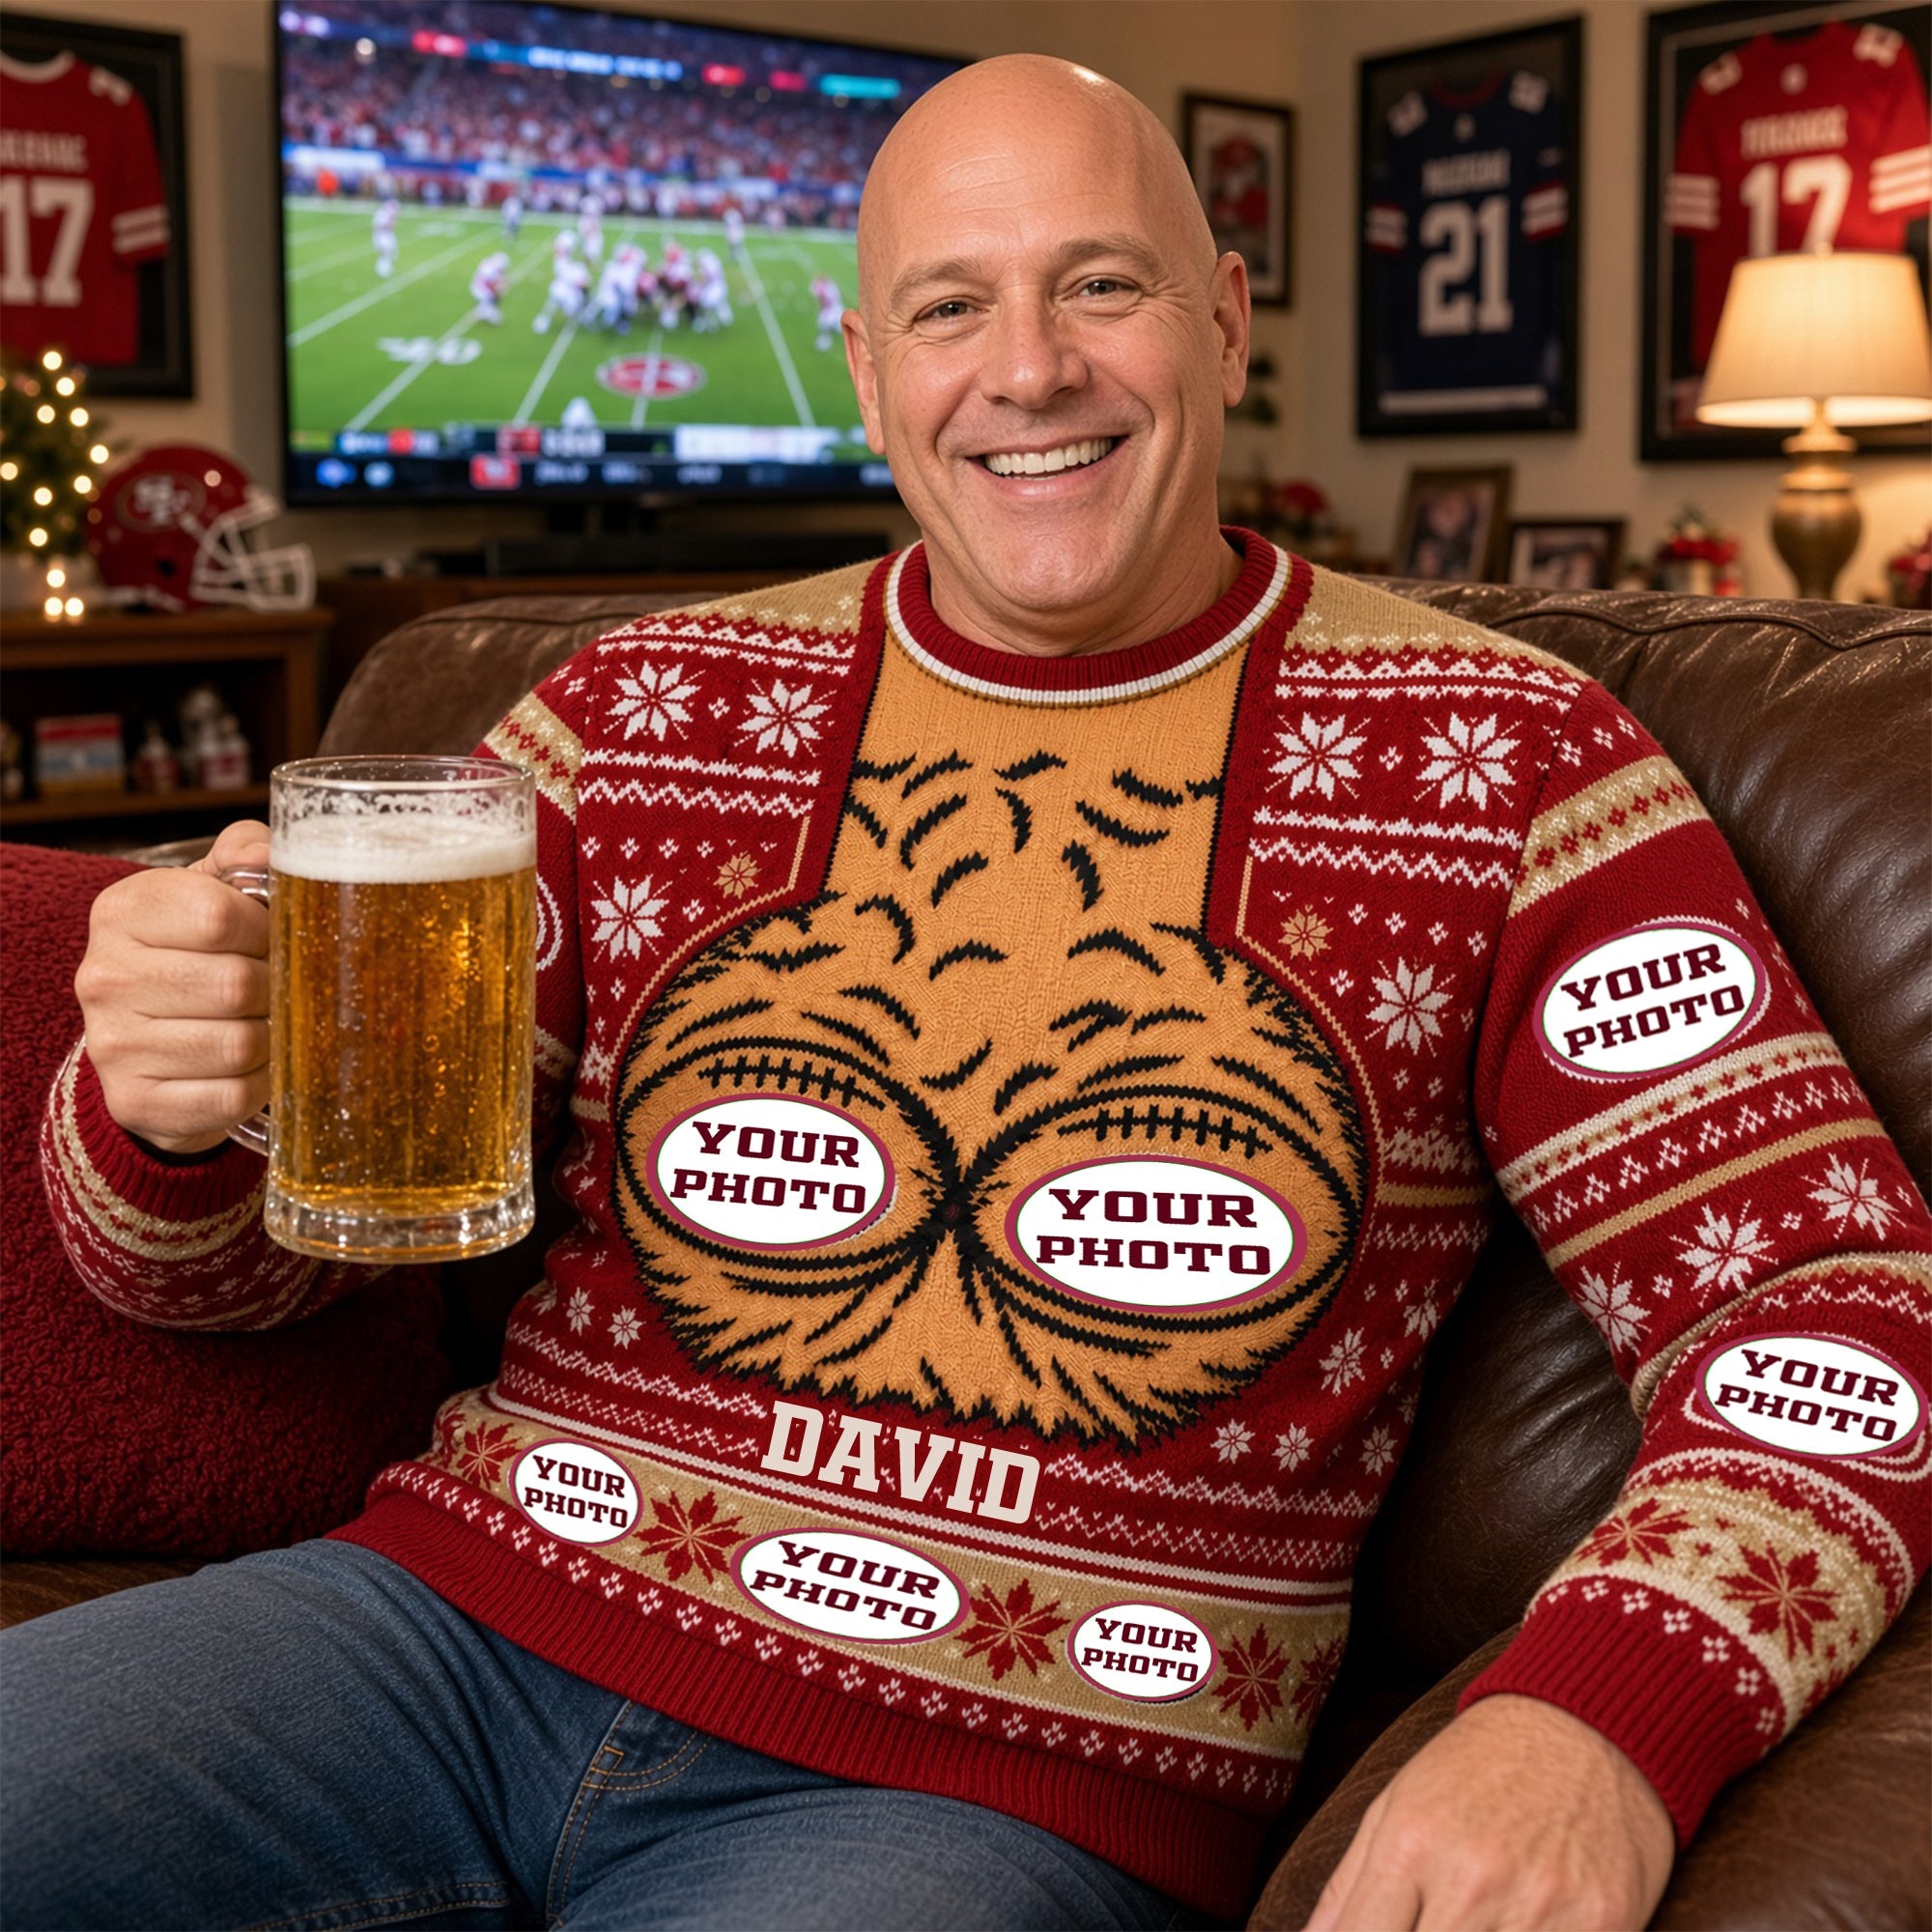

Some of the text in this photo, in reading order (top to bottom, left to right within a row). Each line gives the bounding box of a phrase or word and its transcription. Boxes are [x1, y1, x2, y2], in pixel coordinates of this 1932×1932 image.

[1740, 154, 1854, 261] 17
[0, 175, 95, 306] 17
[1418, 196, 1514, 336] 21
[1560, 943, 1726, 1011] YOUR
[1563, 984, 1746, 1059] PHOTO
[692, 1121, 860, 1169] YOUR
[669, 1168, 867, 1214] PHOTO
[1048, 1188, 1258, 1229] YOUR
[1036, 1235, 1271, 1276] PHOTO
[1741, 1349, 1899, 1406] YOUR
[1714, 1383, 1897, 1442] PHOTO
[532, 1454, 626, 1499] YOUR
[760, 1400, 1040, 1524] DAVID
[524, 1486, 628, 1529] PHOTO
[778, 1540, 940, 1600] YOUR
[750, 1569, 937, 1631] PHOTO
[1081, 1646, 1199, 1683] PHOTO
[1094, 1617, 1198, 1654] YOUR
